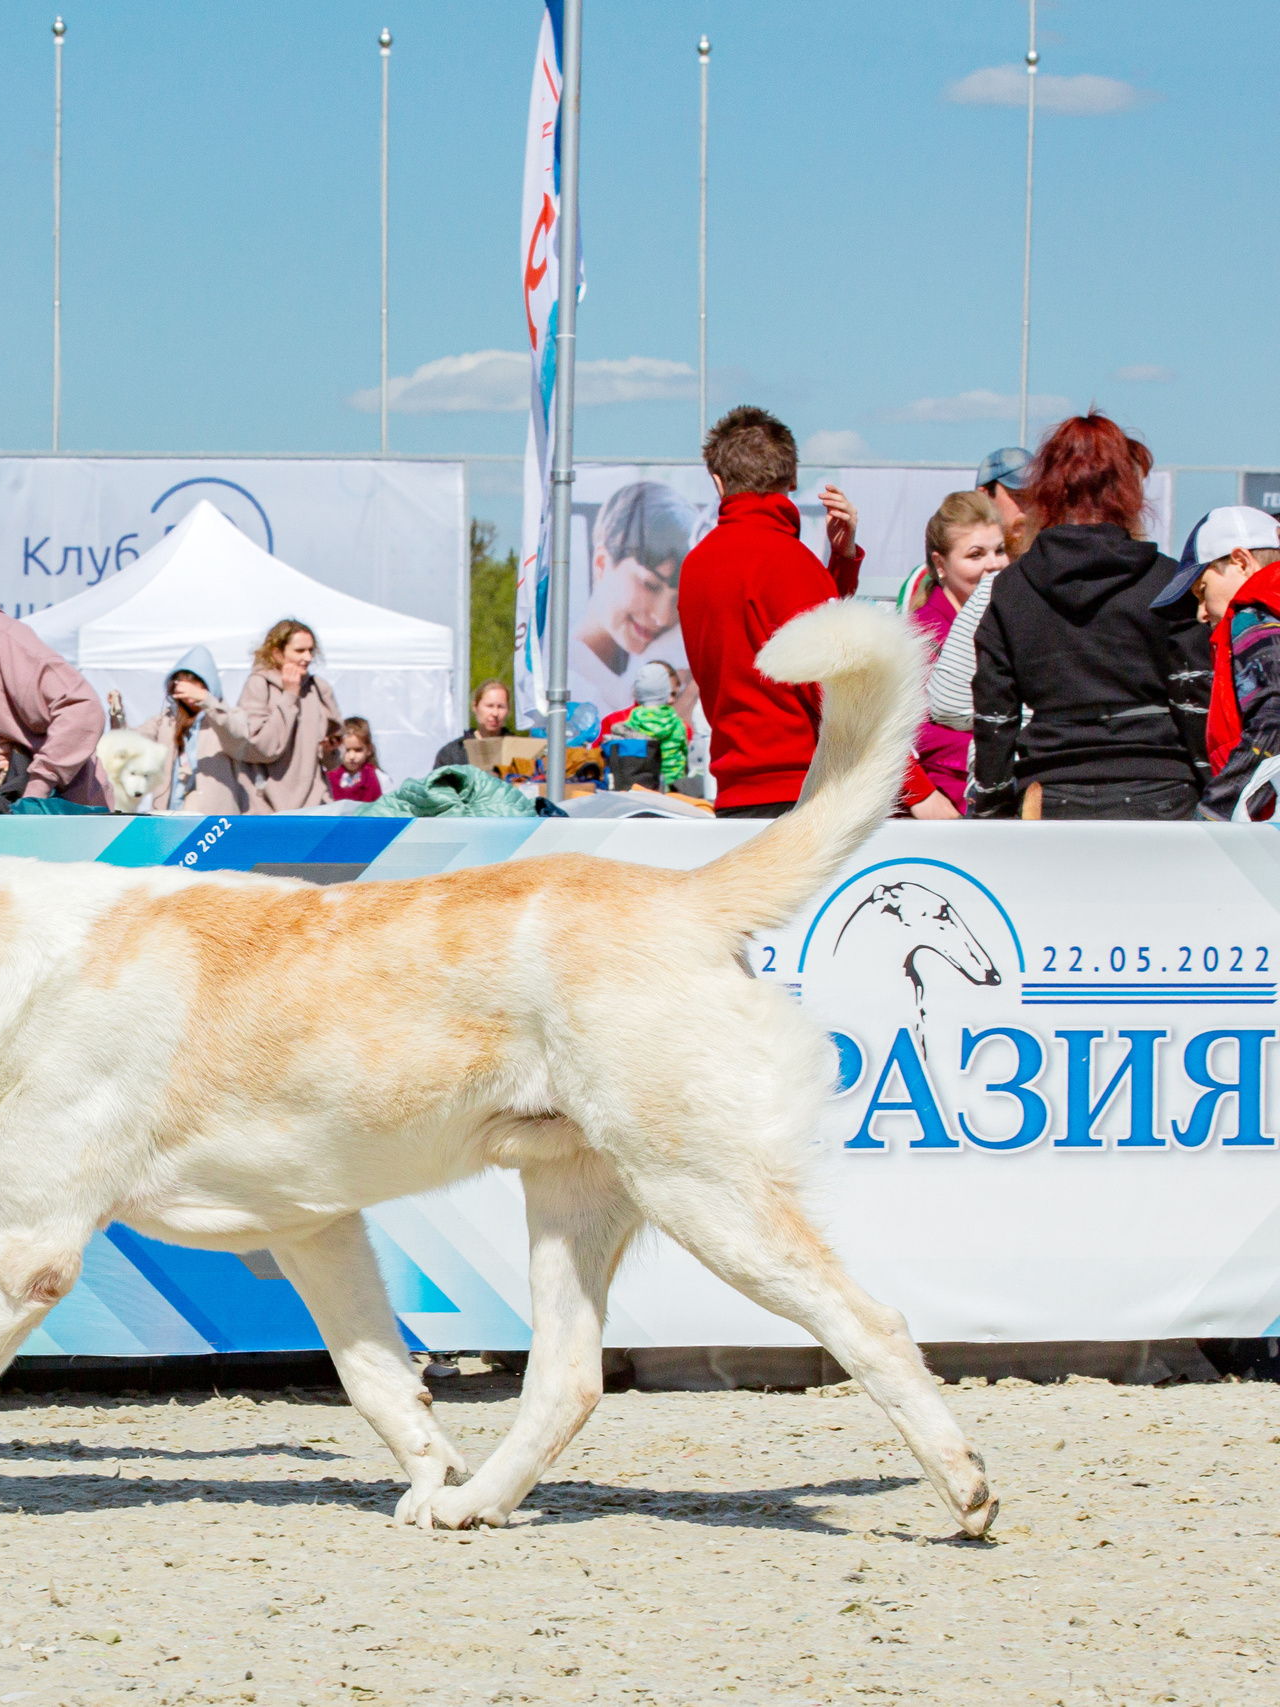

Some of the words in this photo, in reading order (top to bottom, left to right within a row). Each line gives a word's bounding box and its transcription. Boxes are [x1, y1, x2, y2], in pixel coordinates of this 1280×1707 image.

[23, 533, 140, 586] Клуб
[197, 817, 232, 853] 2022
[1042, 945, 1271, 973] 22.05.2022
